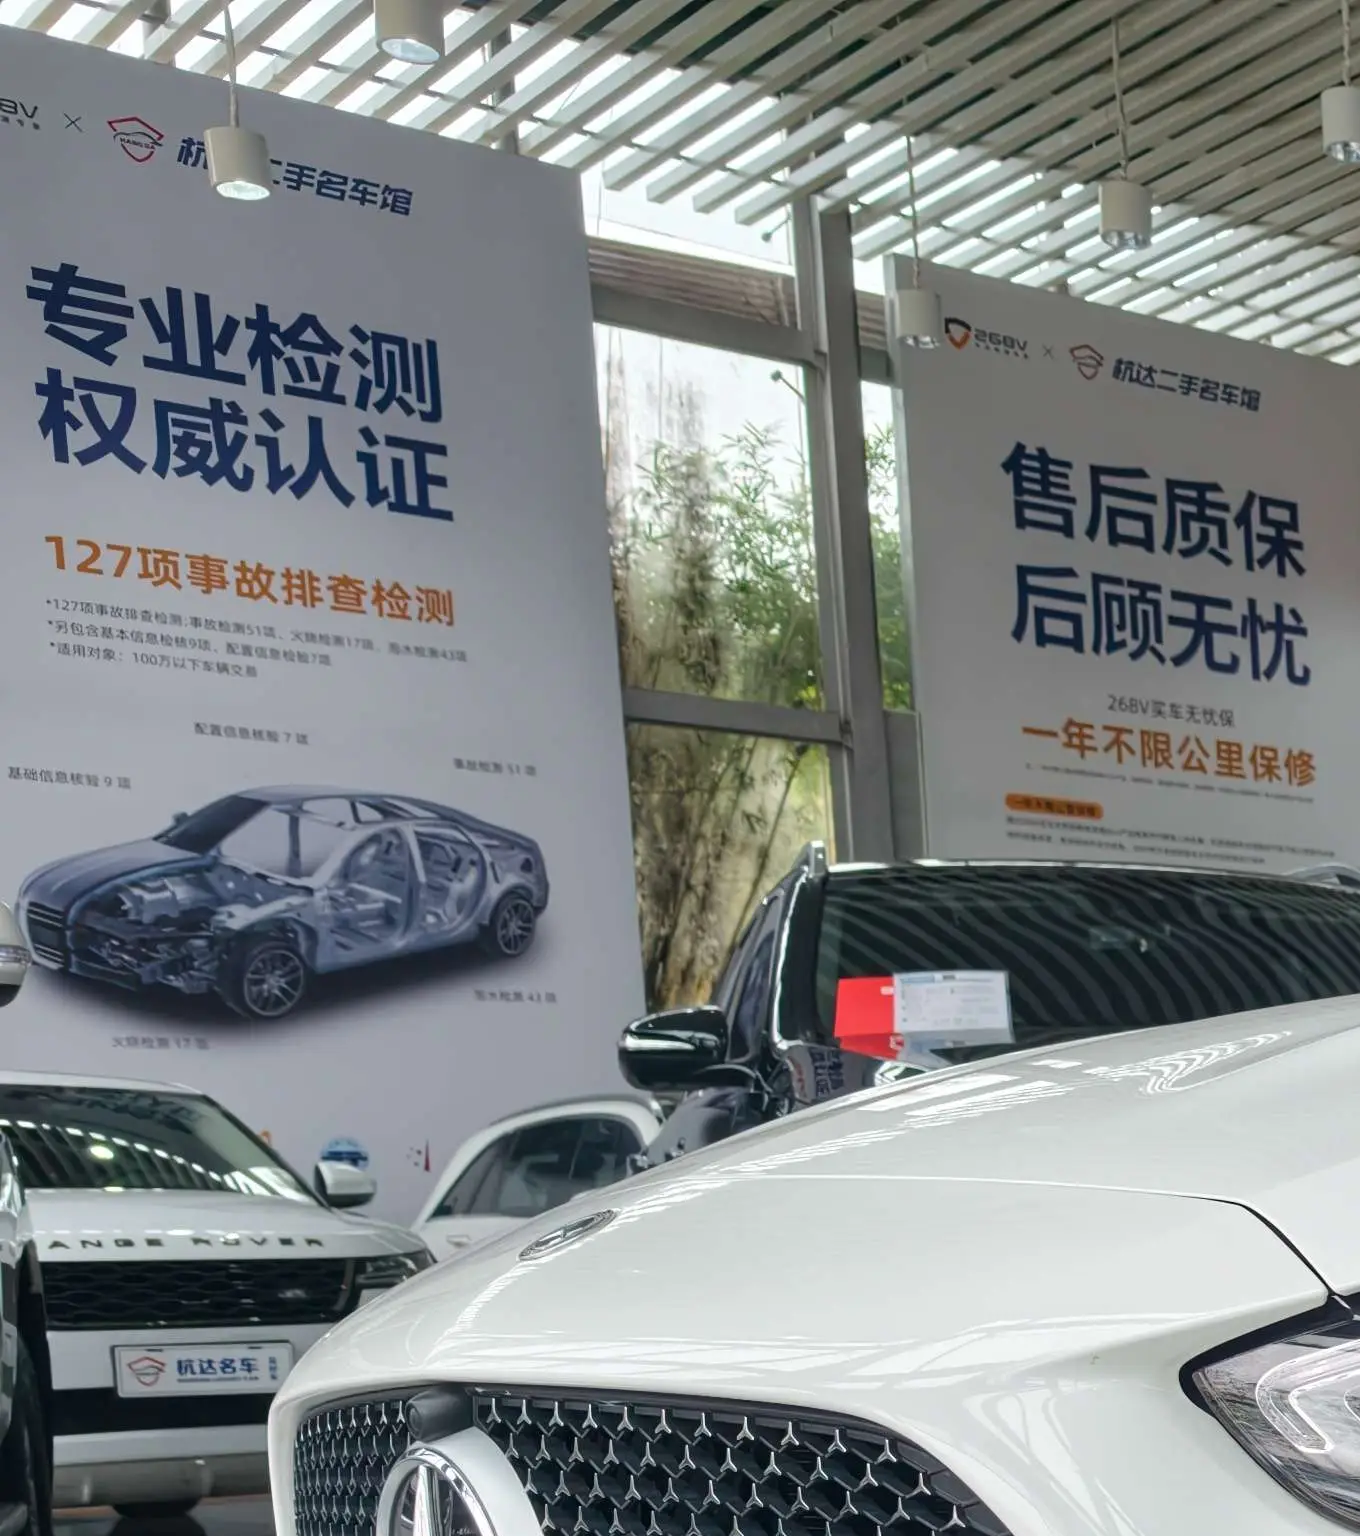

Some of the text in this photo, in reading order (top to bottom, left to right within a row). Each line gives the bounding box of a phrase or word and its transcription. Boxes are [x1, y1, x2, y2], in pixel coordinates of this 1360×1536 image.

[177, 137, 413, 216] 杭手名车馆
[25, 262, 443, 424] 专业检测
[1112, 357, 1261, 412] 杭达二手名车馆
[34, 367, 455, 522] 权威认证
[1001, 441, 1307, 578] 售后质保
[44, 534, 456, 627] 127项事故排查检测
[1011, 564, 1311, 686] 后顾无忧
[1021, 718, 1318, 787] 一年不限公里保修
[49, 1239, 164, 1250] ANGE
[177, 1357, 259, 1376] 杭达名车
